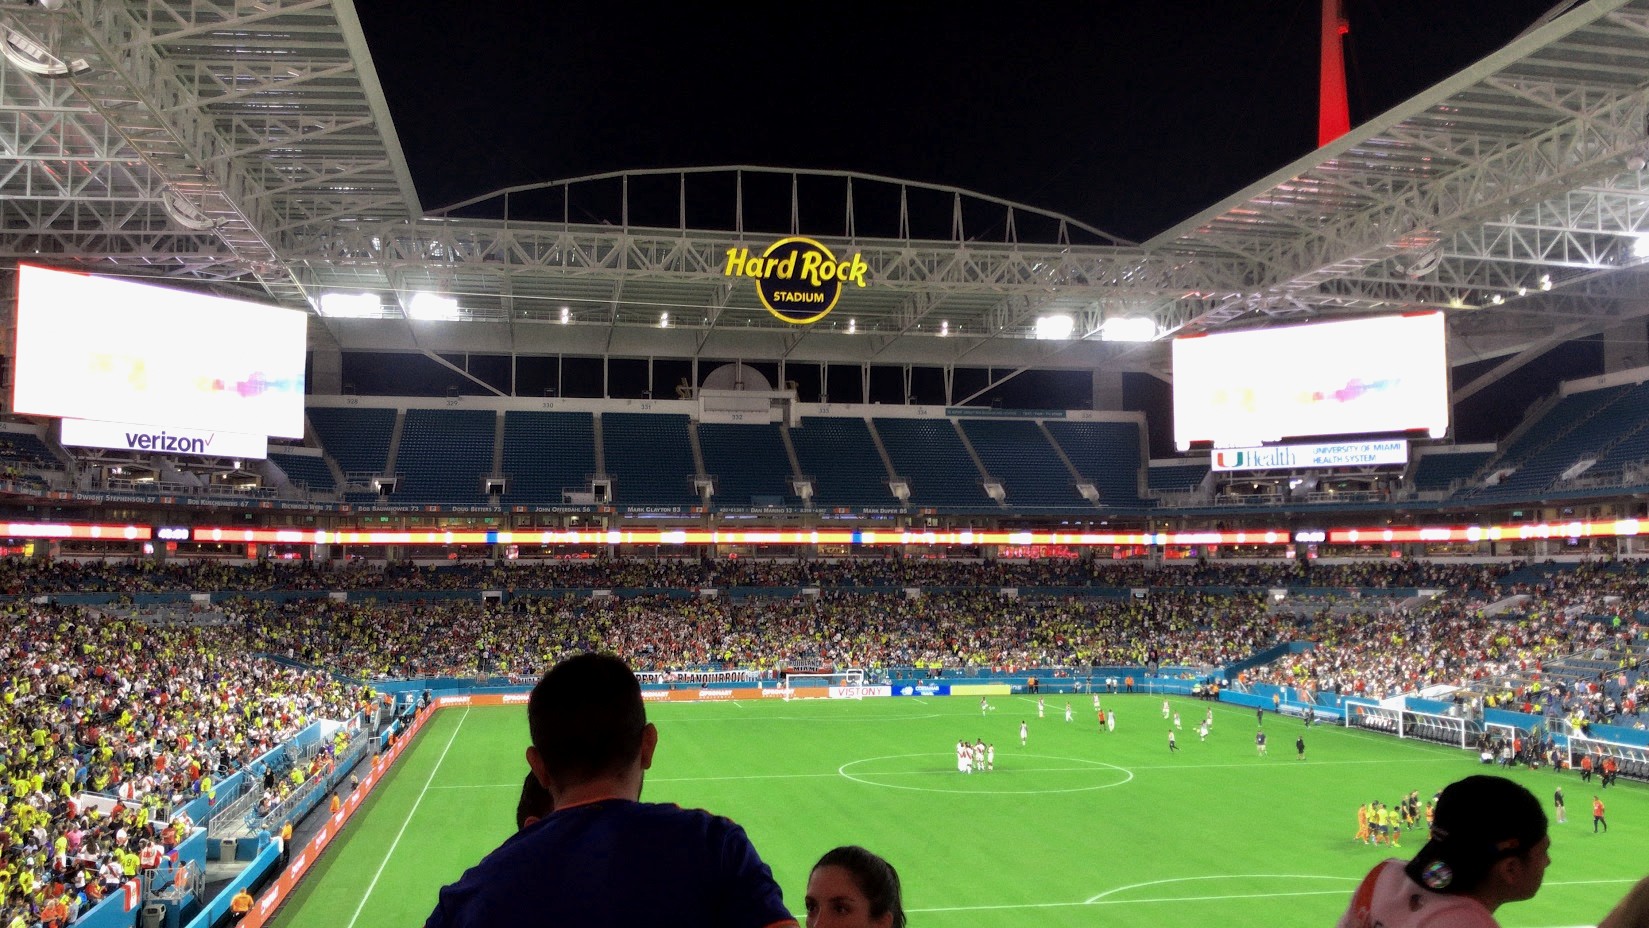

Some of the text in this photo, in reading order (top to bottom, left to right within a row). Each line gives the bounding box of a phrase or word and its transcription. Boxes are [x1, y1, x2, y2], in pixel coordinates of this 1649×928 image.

[725, 248, 868, 287] Hard Rock
[773, 291, 824, 303] STADIUM
[126, 431, 204, 453] verizon
[1313, 445, 1358, 455] UNIVERSITY
[1373, 443, 1402, 452] MIAMI
[1313, 454, 1377, 464] HEALTH SYSTEM
[77, 493, 104, 502] DWIGHT
[105, 494, 146, 503] STEPHENSON
[838, 687, 882, 697] VISTONY
